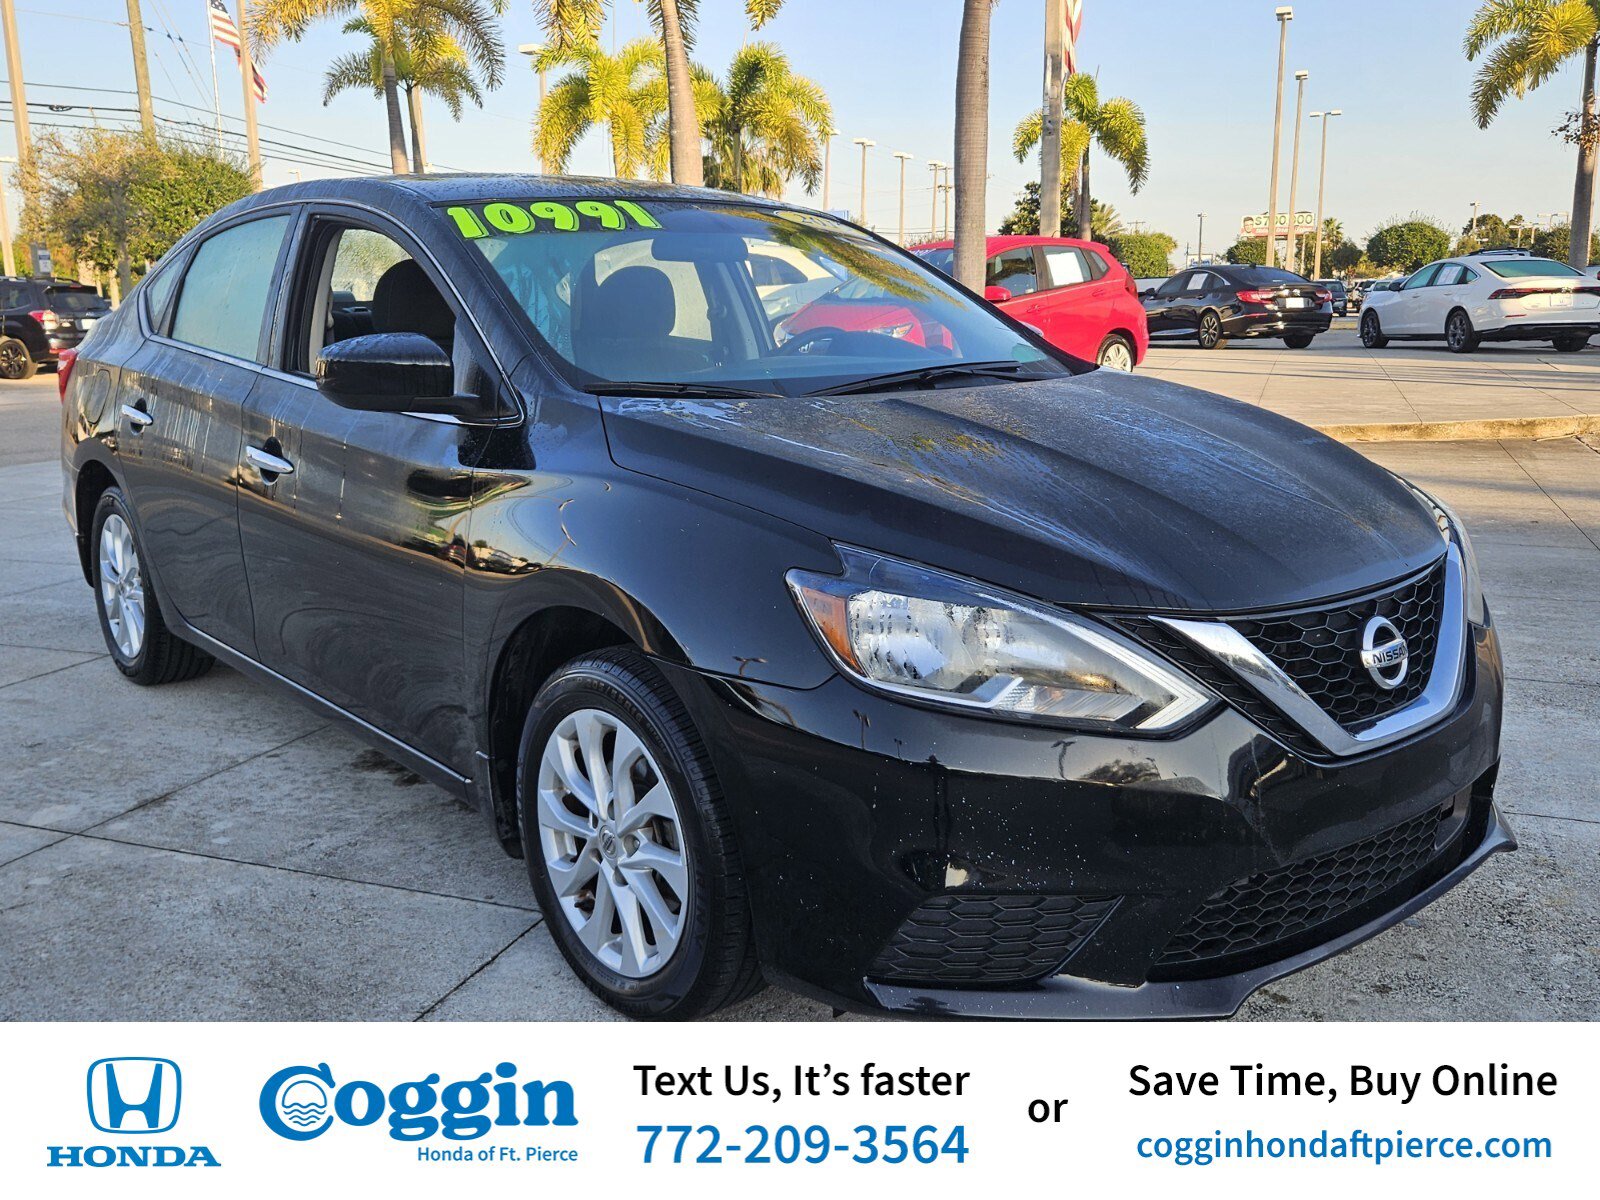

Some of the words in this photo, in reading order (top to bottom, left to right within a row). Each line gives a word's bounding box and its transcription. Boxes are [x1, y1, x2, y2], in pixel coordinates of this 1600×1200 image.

[447, 200, 663, 239] 10991
[1255, 214, 1313, 226] $70,00
[1373, 646, 1407, 665] NISSAN
